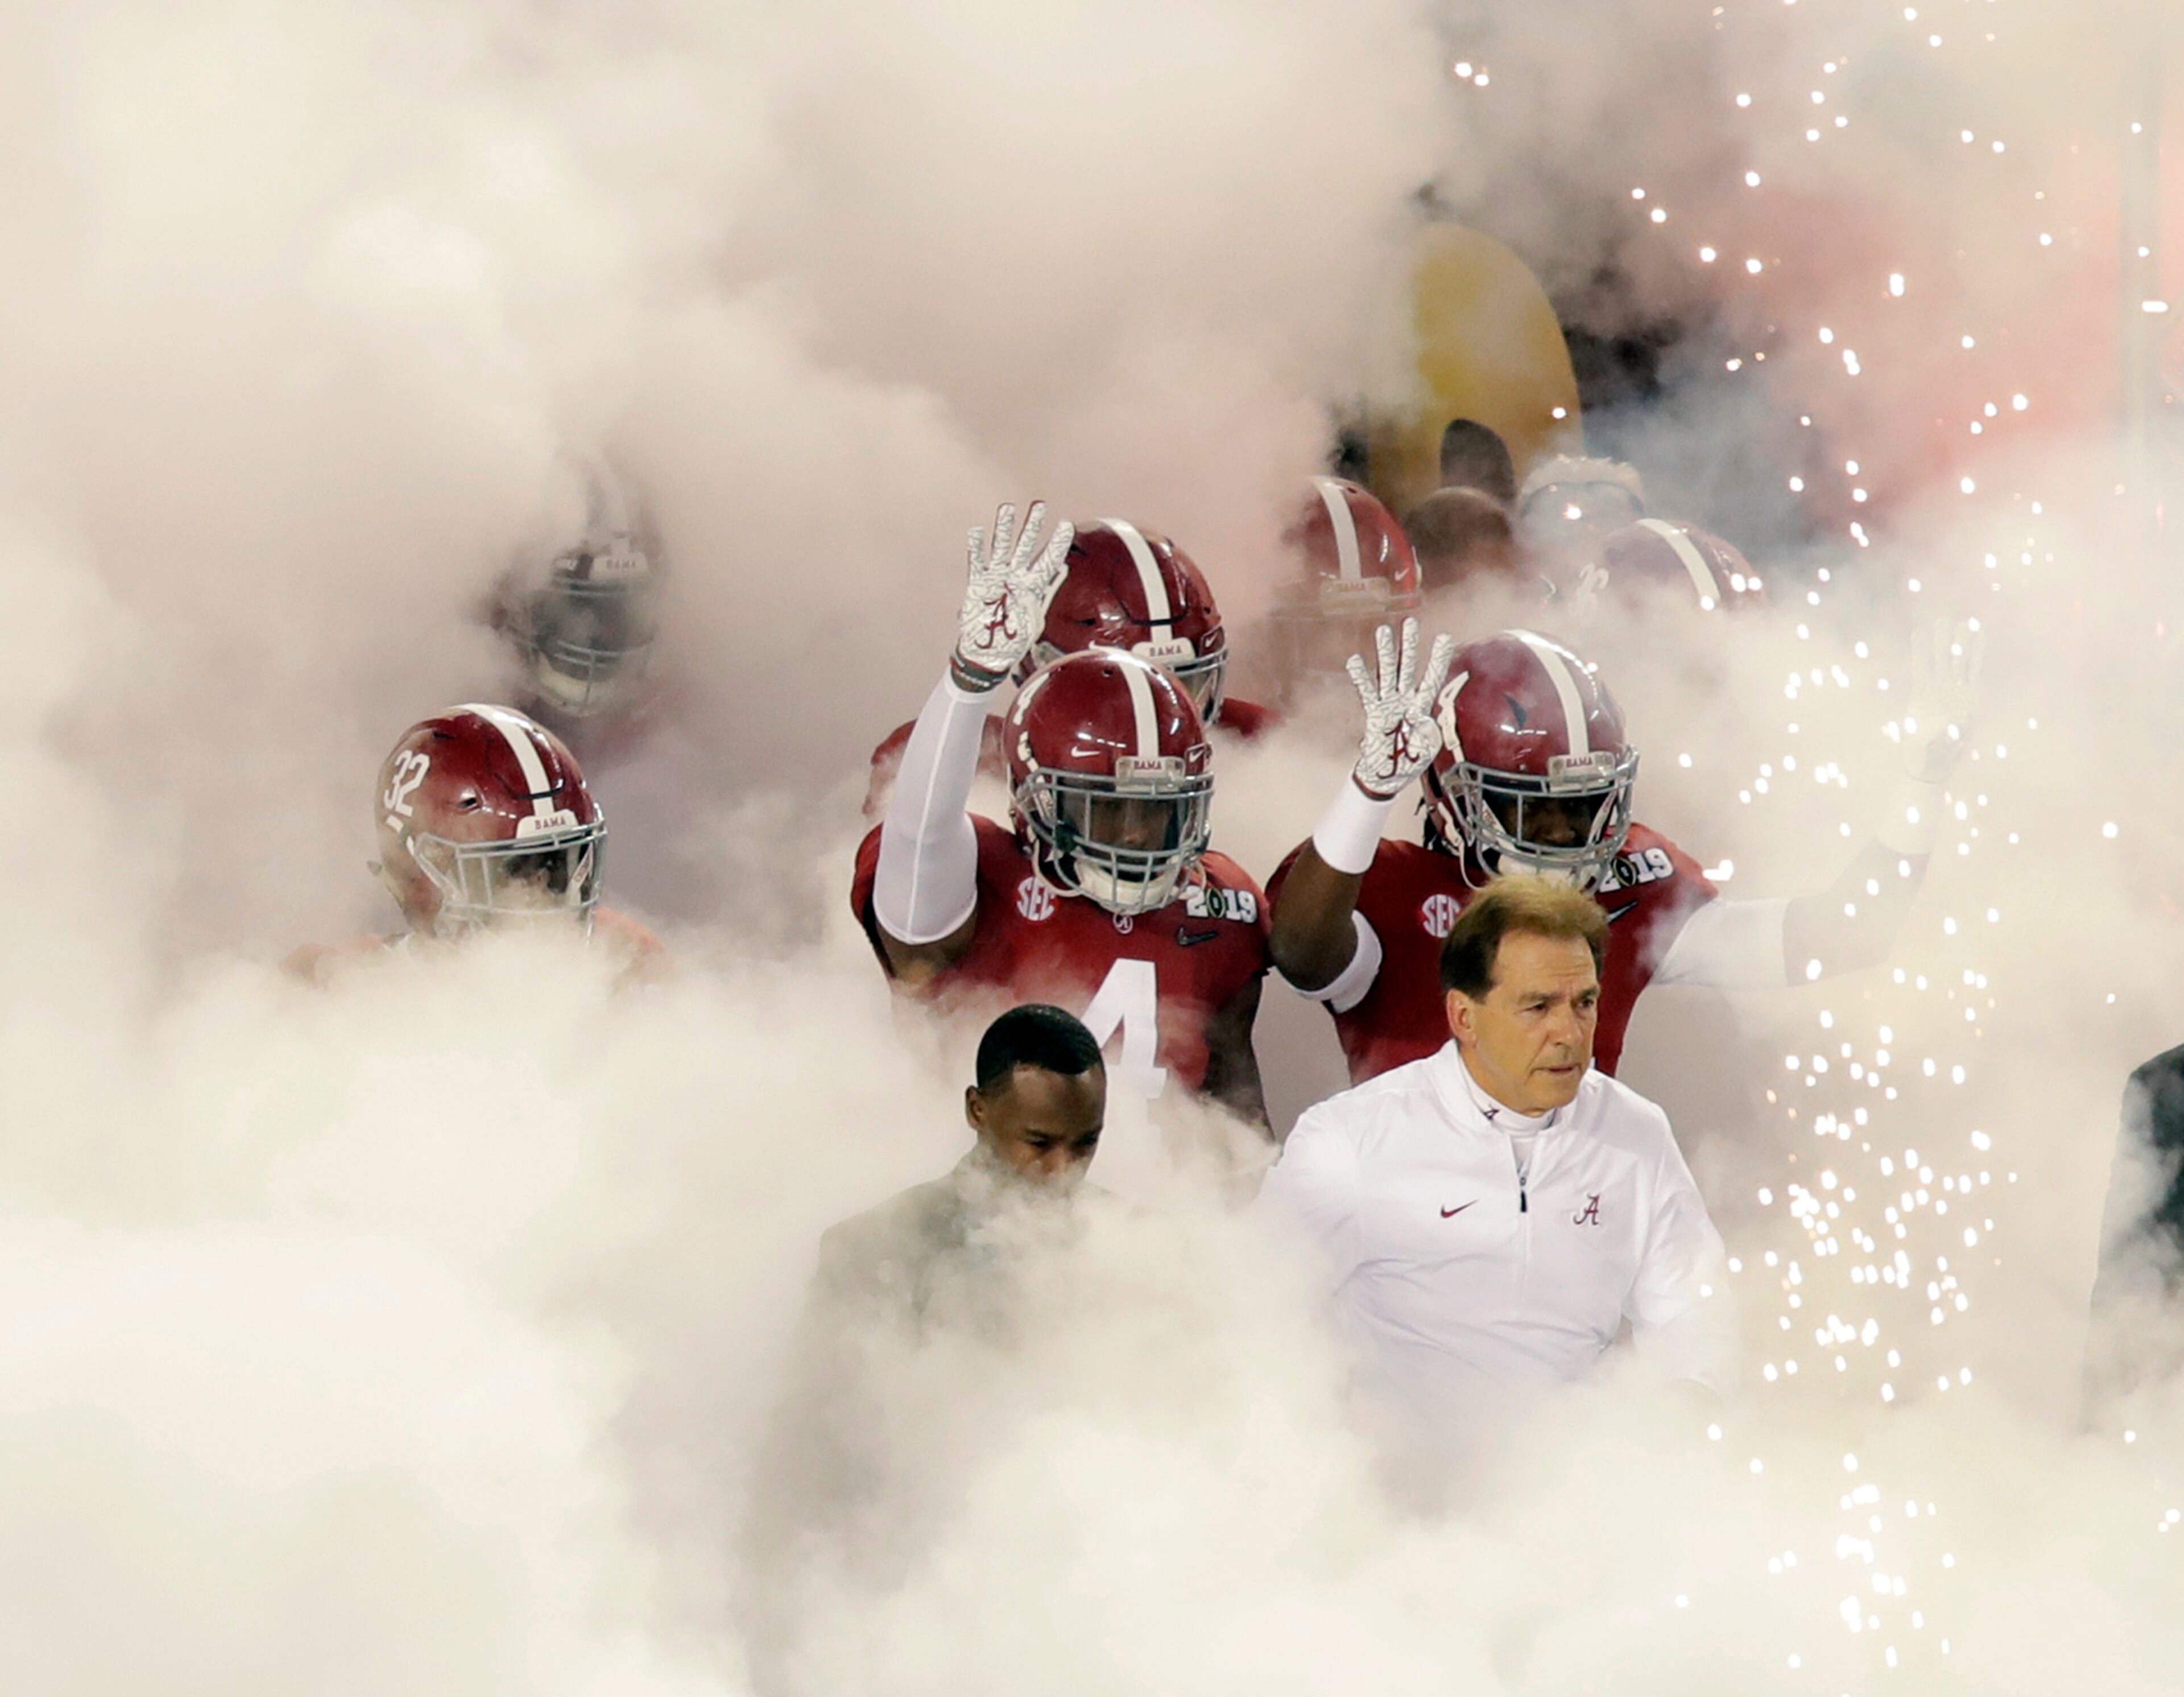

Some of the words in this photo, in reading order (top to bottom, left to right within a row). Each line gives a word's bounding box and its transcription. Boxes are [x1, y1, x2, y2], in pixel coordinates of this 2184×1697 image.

[974, 589, 1017, 649] A
[1149, 644, 1183, 657] BAMA
[1133, 760, 1162, 771] BAMA
[1376, 718, 1420, 780] A
[1566, 756, 1593, 768] BAMA
[383, 750, 431, 817] 32
[535, 815, 567, 830] BAMA
[1016, 876, 1056, 921] SEC
[1185, 884, 1258, 924] 2019
[1079, 958, 1168, 1137] 4
[1573, 1193, 1600, 1226] A
